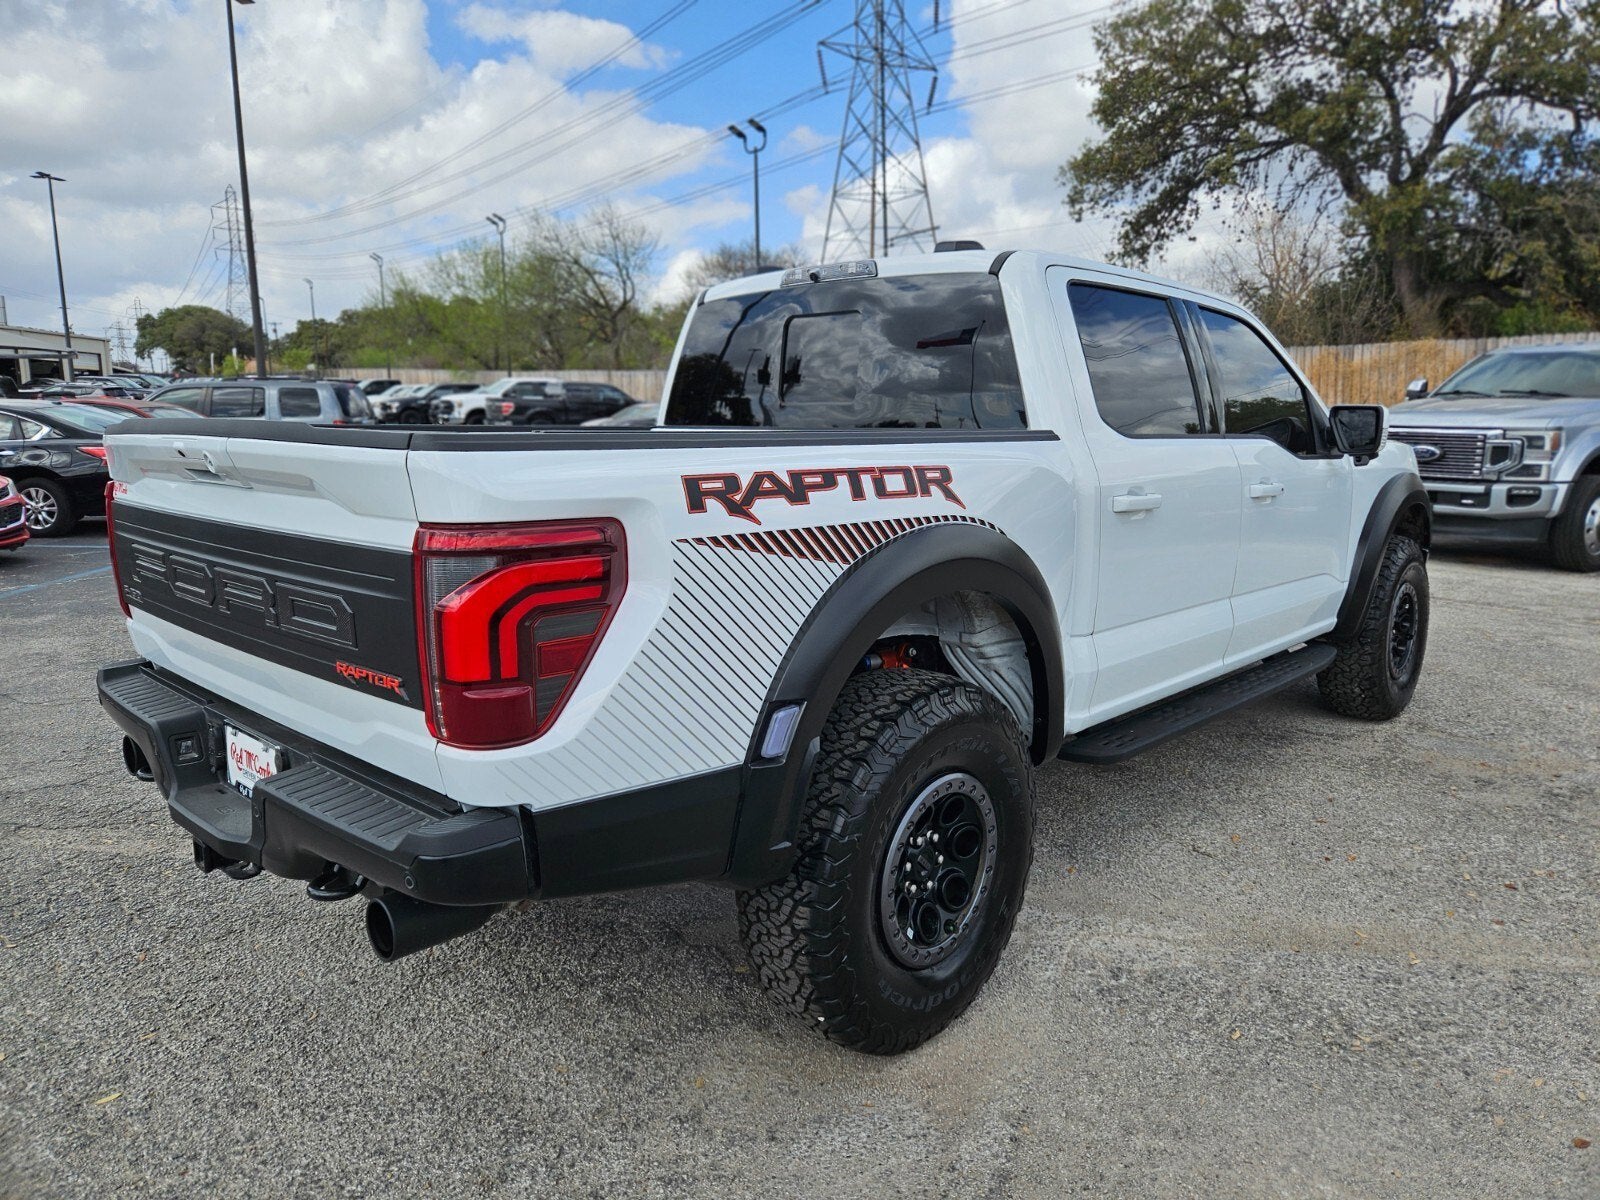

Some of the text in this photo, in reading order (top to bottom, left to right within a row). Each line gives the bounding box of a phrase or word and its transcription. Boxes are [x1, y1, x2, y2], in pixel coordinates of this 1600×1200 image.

[681, 464, 966, 526] RAPTOR
[131, 543, 359, 651] FORD
[336, 661, 407, 700] RAPTOR
